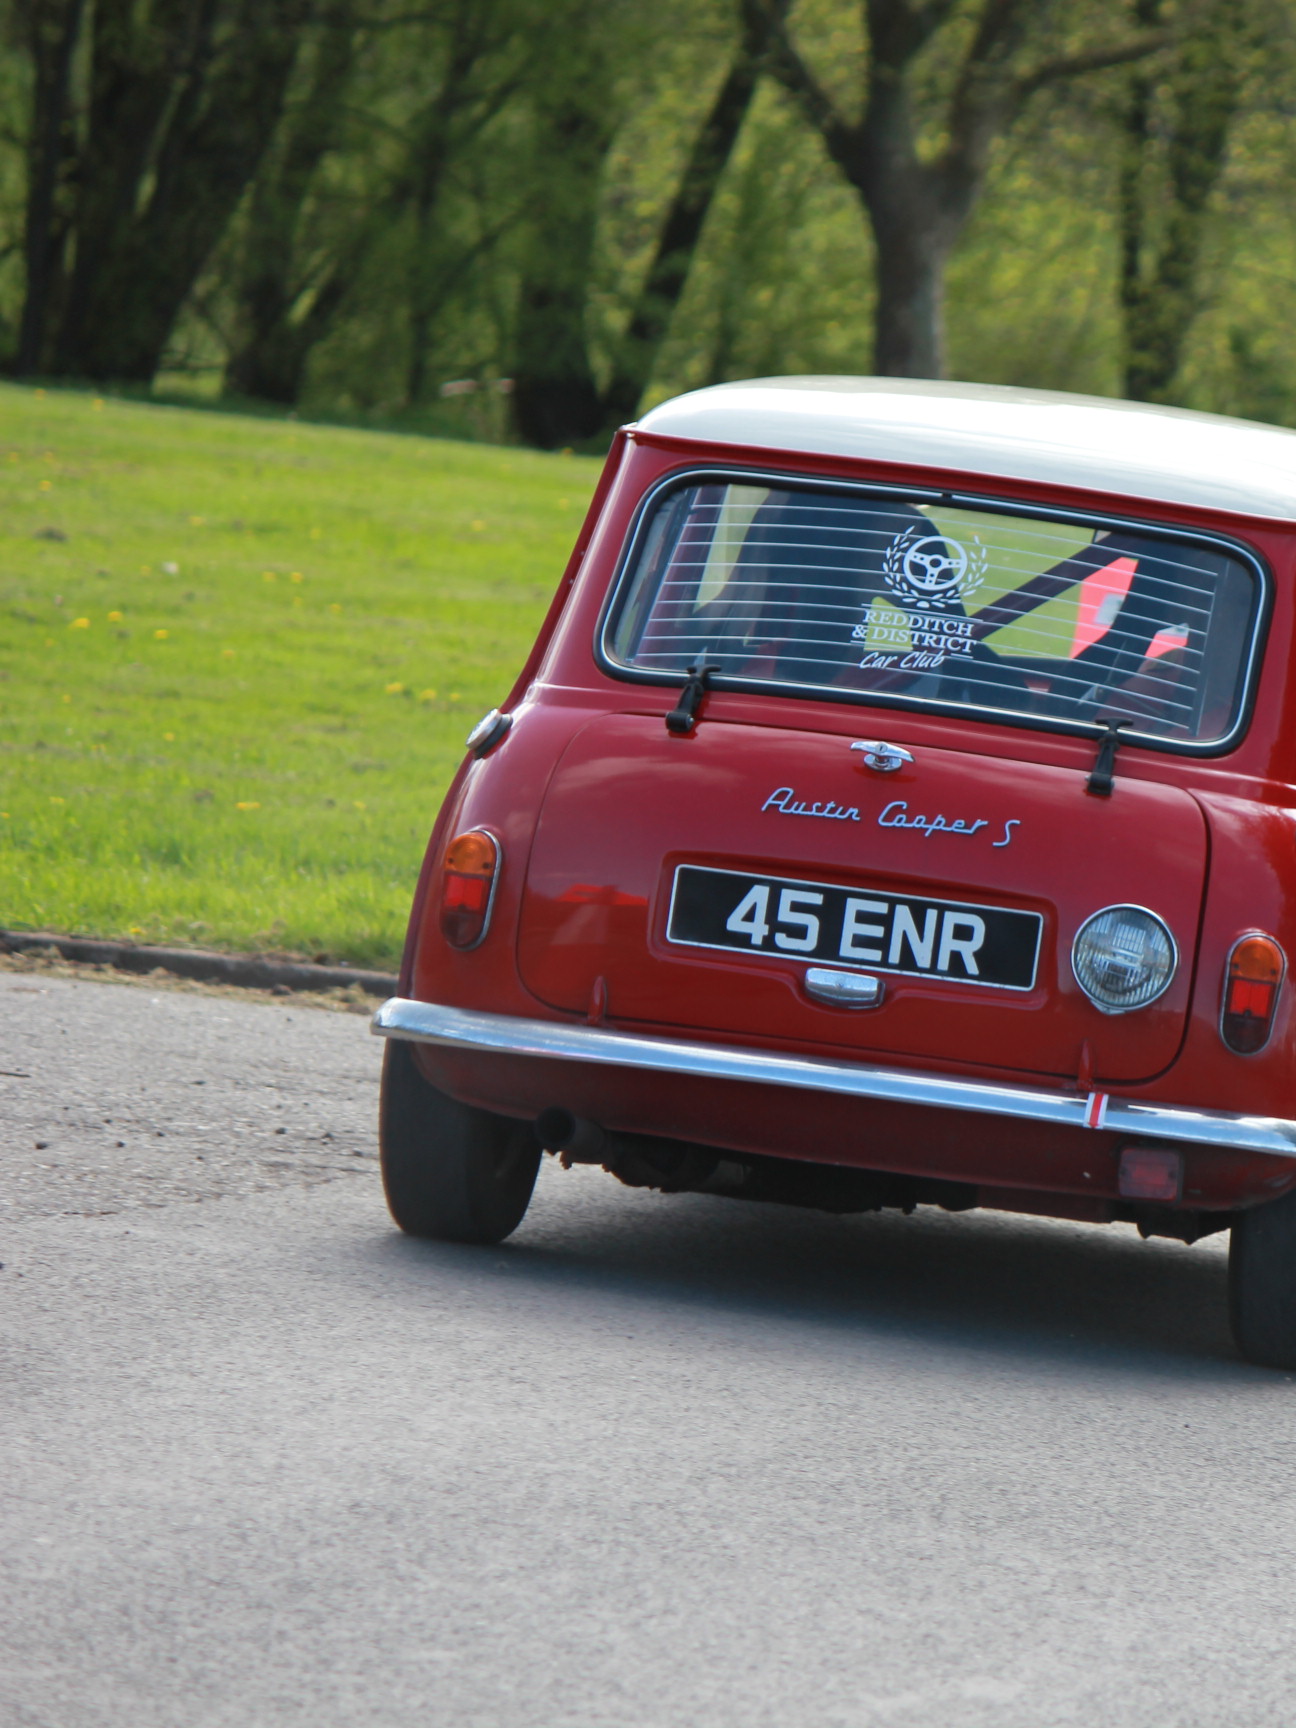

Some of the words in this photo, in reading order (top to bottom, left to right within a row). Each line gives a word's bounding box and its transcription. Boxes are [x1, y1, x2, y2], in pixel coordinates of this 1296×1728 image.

[863, 609, 975, 637] REDDITCH
[852, 624, 869, 638] &
[871, 627, 977, 653] DISTRICT
[860, 651, 897, 669] Car
[900, 649, 945, 669] Club
[761, 787, 861, 820] Austin
[878, 801, 988, 836] Cooper
[992, 819, 1021, 846] S
[726, 884, 824, 952] 45
[839, 897, 986, 976] ENR
